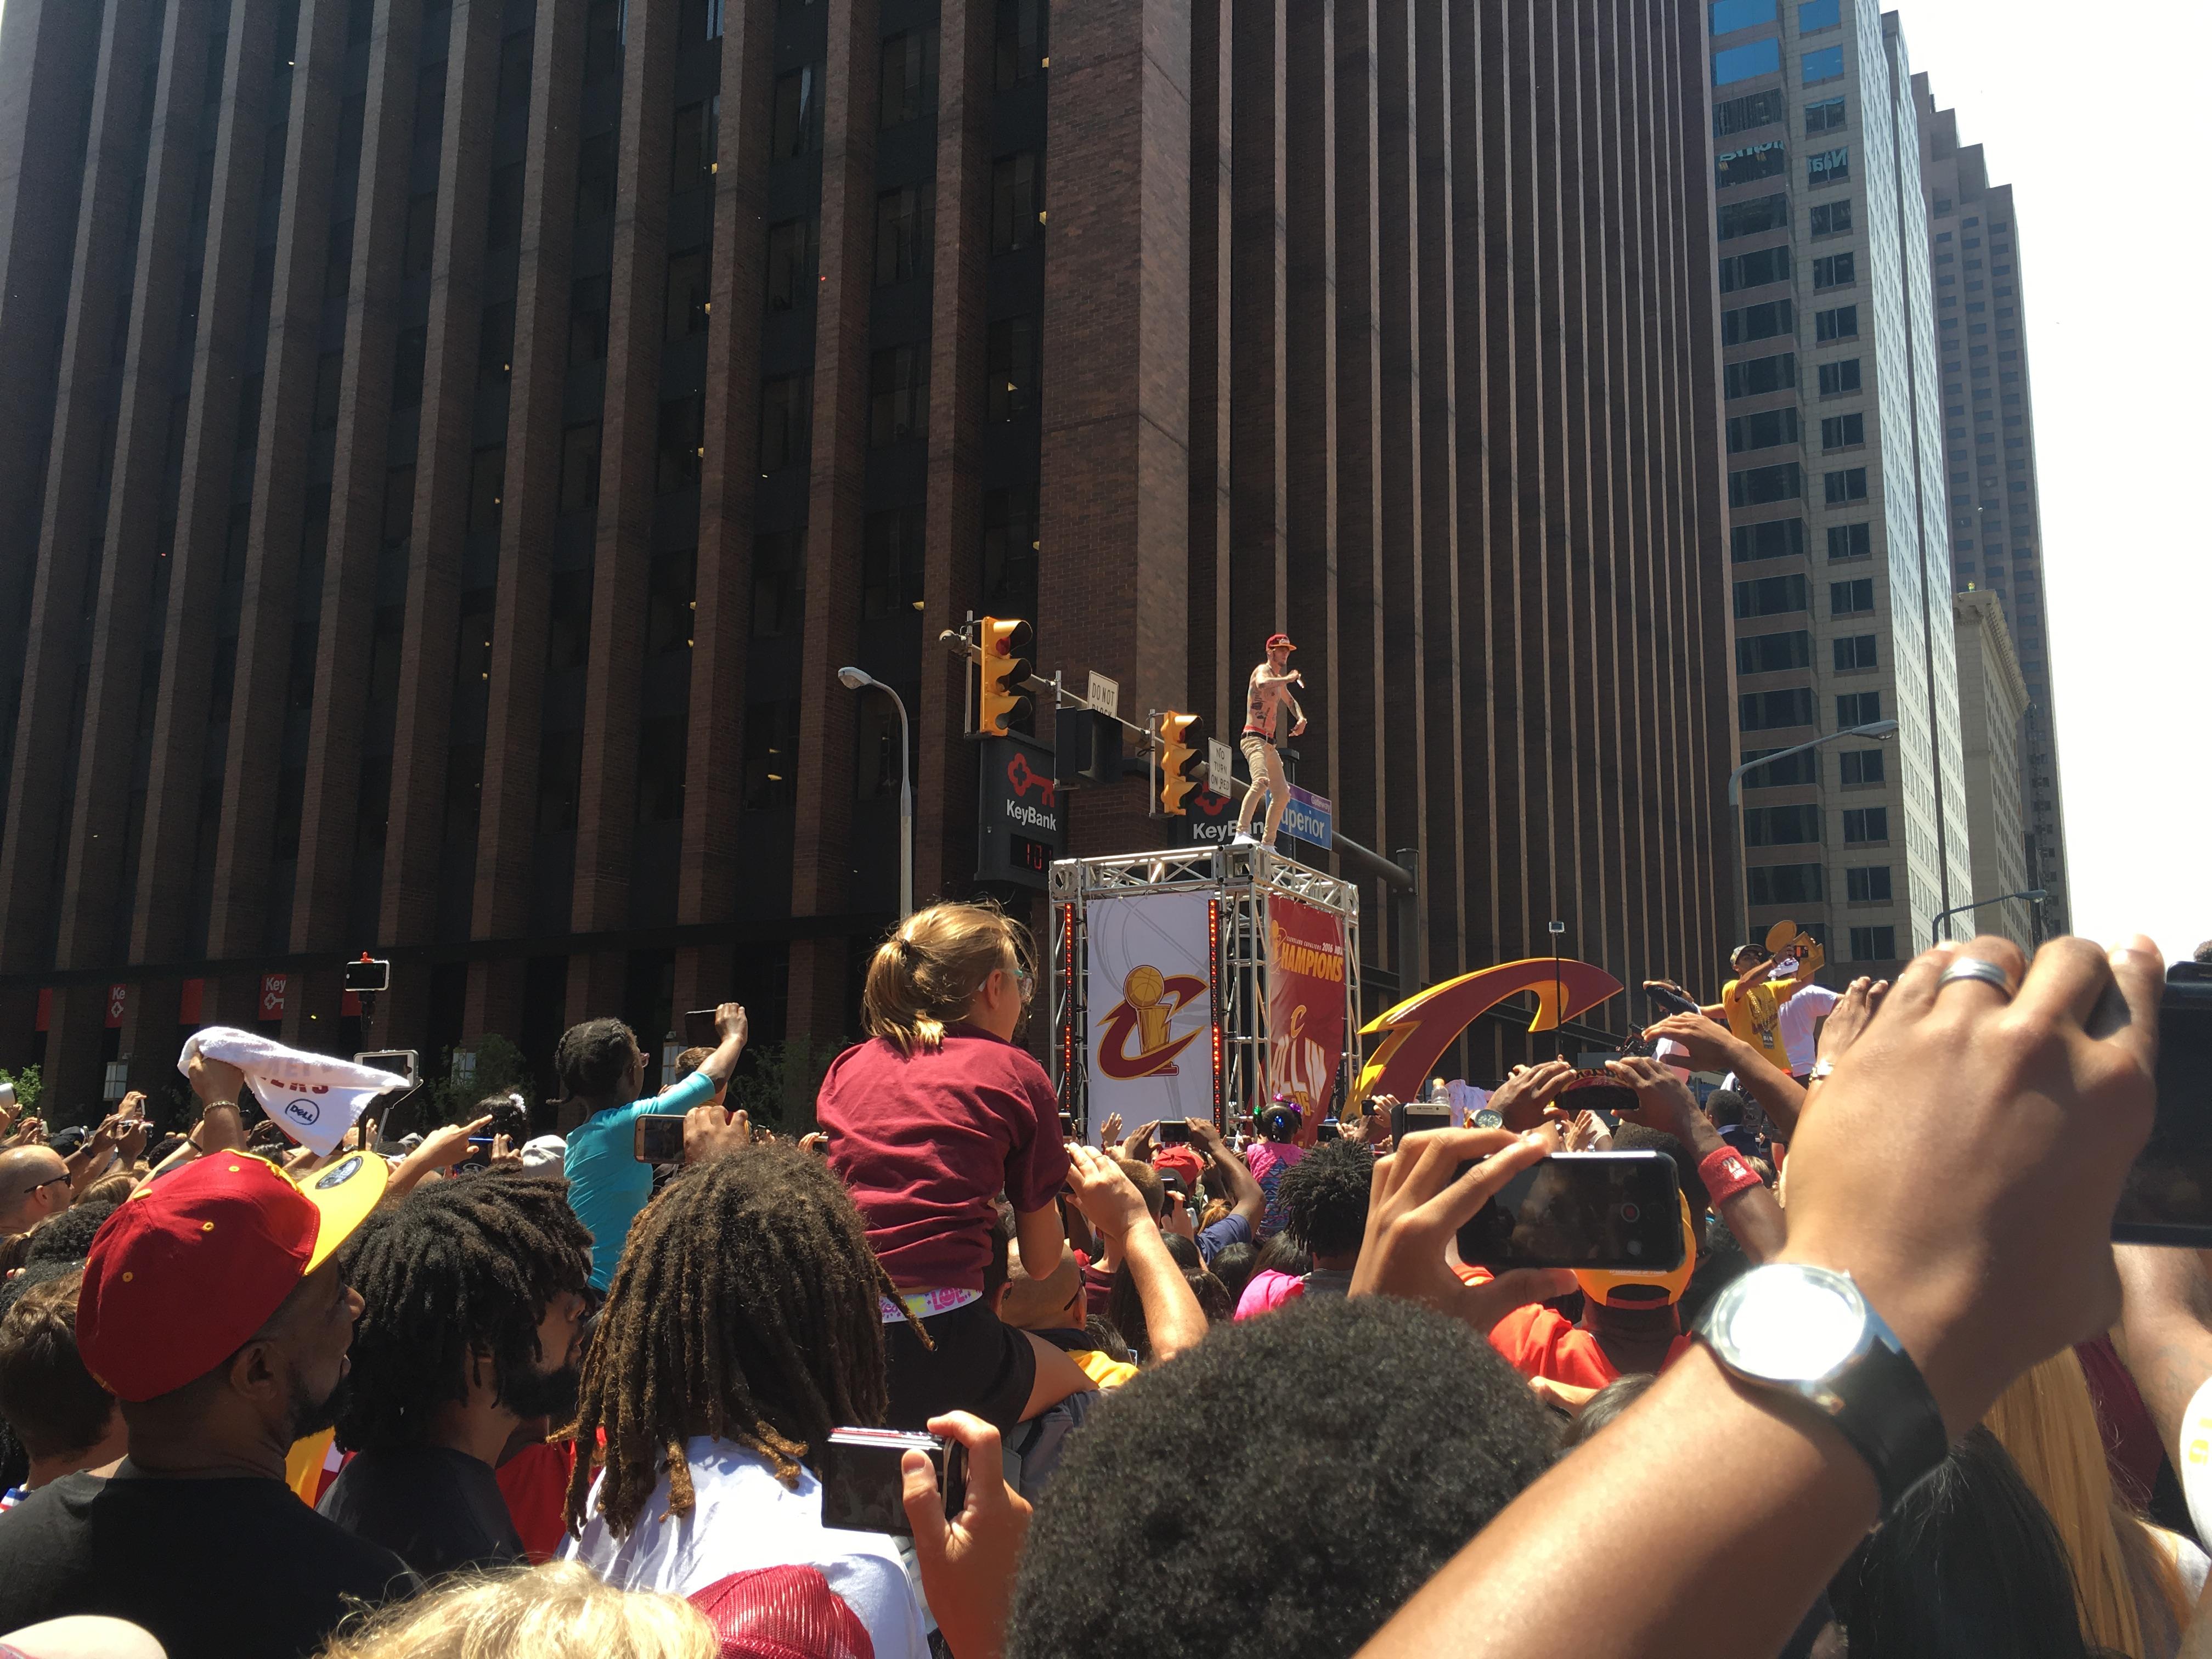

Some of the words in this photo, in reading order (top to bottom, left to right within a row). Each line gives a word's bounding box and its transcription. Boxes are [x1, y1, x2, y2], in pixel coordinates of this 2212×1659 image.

[1092, 682, 1101, 701] DO
[1102, 687, 1115, 707] NOT
[1216, 747, 1224, 760] NO
[1214, 761, 1228, 775] TURN
[1211, 774, 1218, 786] ON
[1220, 778, 1229, 791] RED
[1007, 799, 1057, 831] KeyBank
[1280, 808, 1324, 839] uperior
[1193, 820, 1264, 842] KeyBn
[1286, 935, 1303, 945] CLEVELAND
[1322, 942, 1333, 953] 2016
[1334, 945, 1343, 955] NBA
[112, 988, 125, 1000] Ke
[266, 980, 286, 993] Key
[290, 1104, 313, 1122] DELL
[1722, 1157, 1741, 1173] 23
